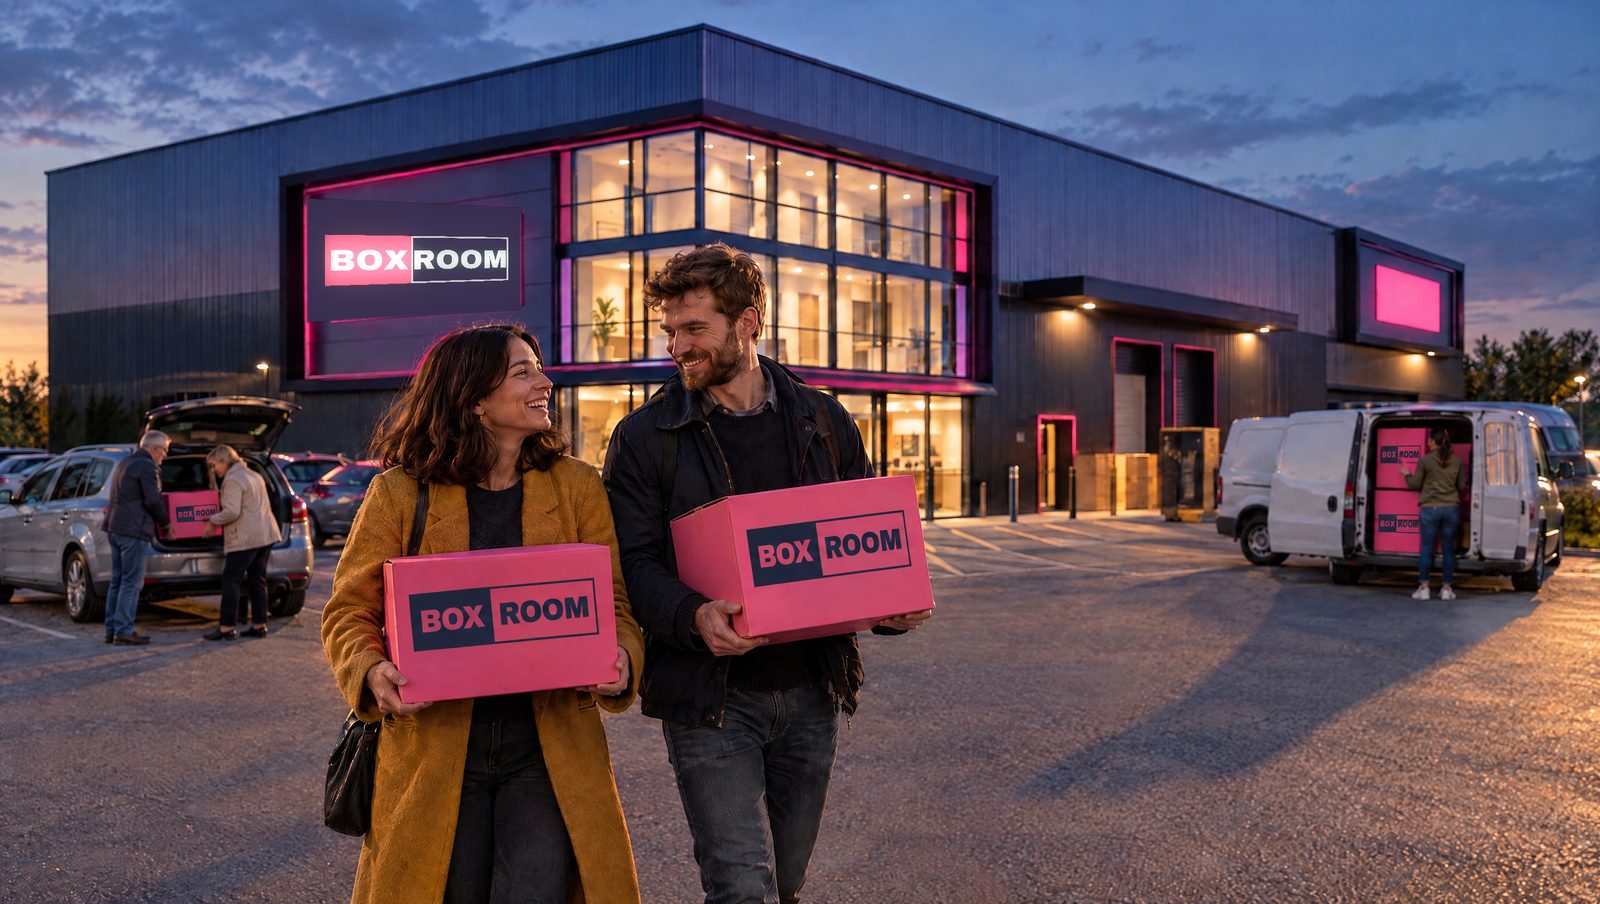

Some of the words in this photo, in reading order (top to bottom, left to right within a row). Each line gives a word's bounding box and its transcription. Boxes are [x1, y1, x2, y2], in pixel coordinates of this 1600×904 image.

[330, 249, 408, 271] BOX
[413, 249, 507, 270] ROOM
[1399, 450, 1420, 458] ROOM
[195, 509, 217, 517] ROOM
[757, 538, 814, 568] BOX
[824, 528, 902, 559] ROOM
[420, 604, 486, 633] BOX
[499, 596, 589, 625] ROOM
